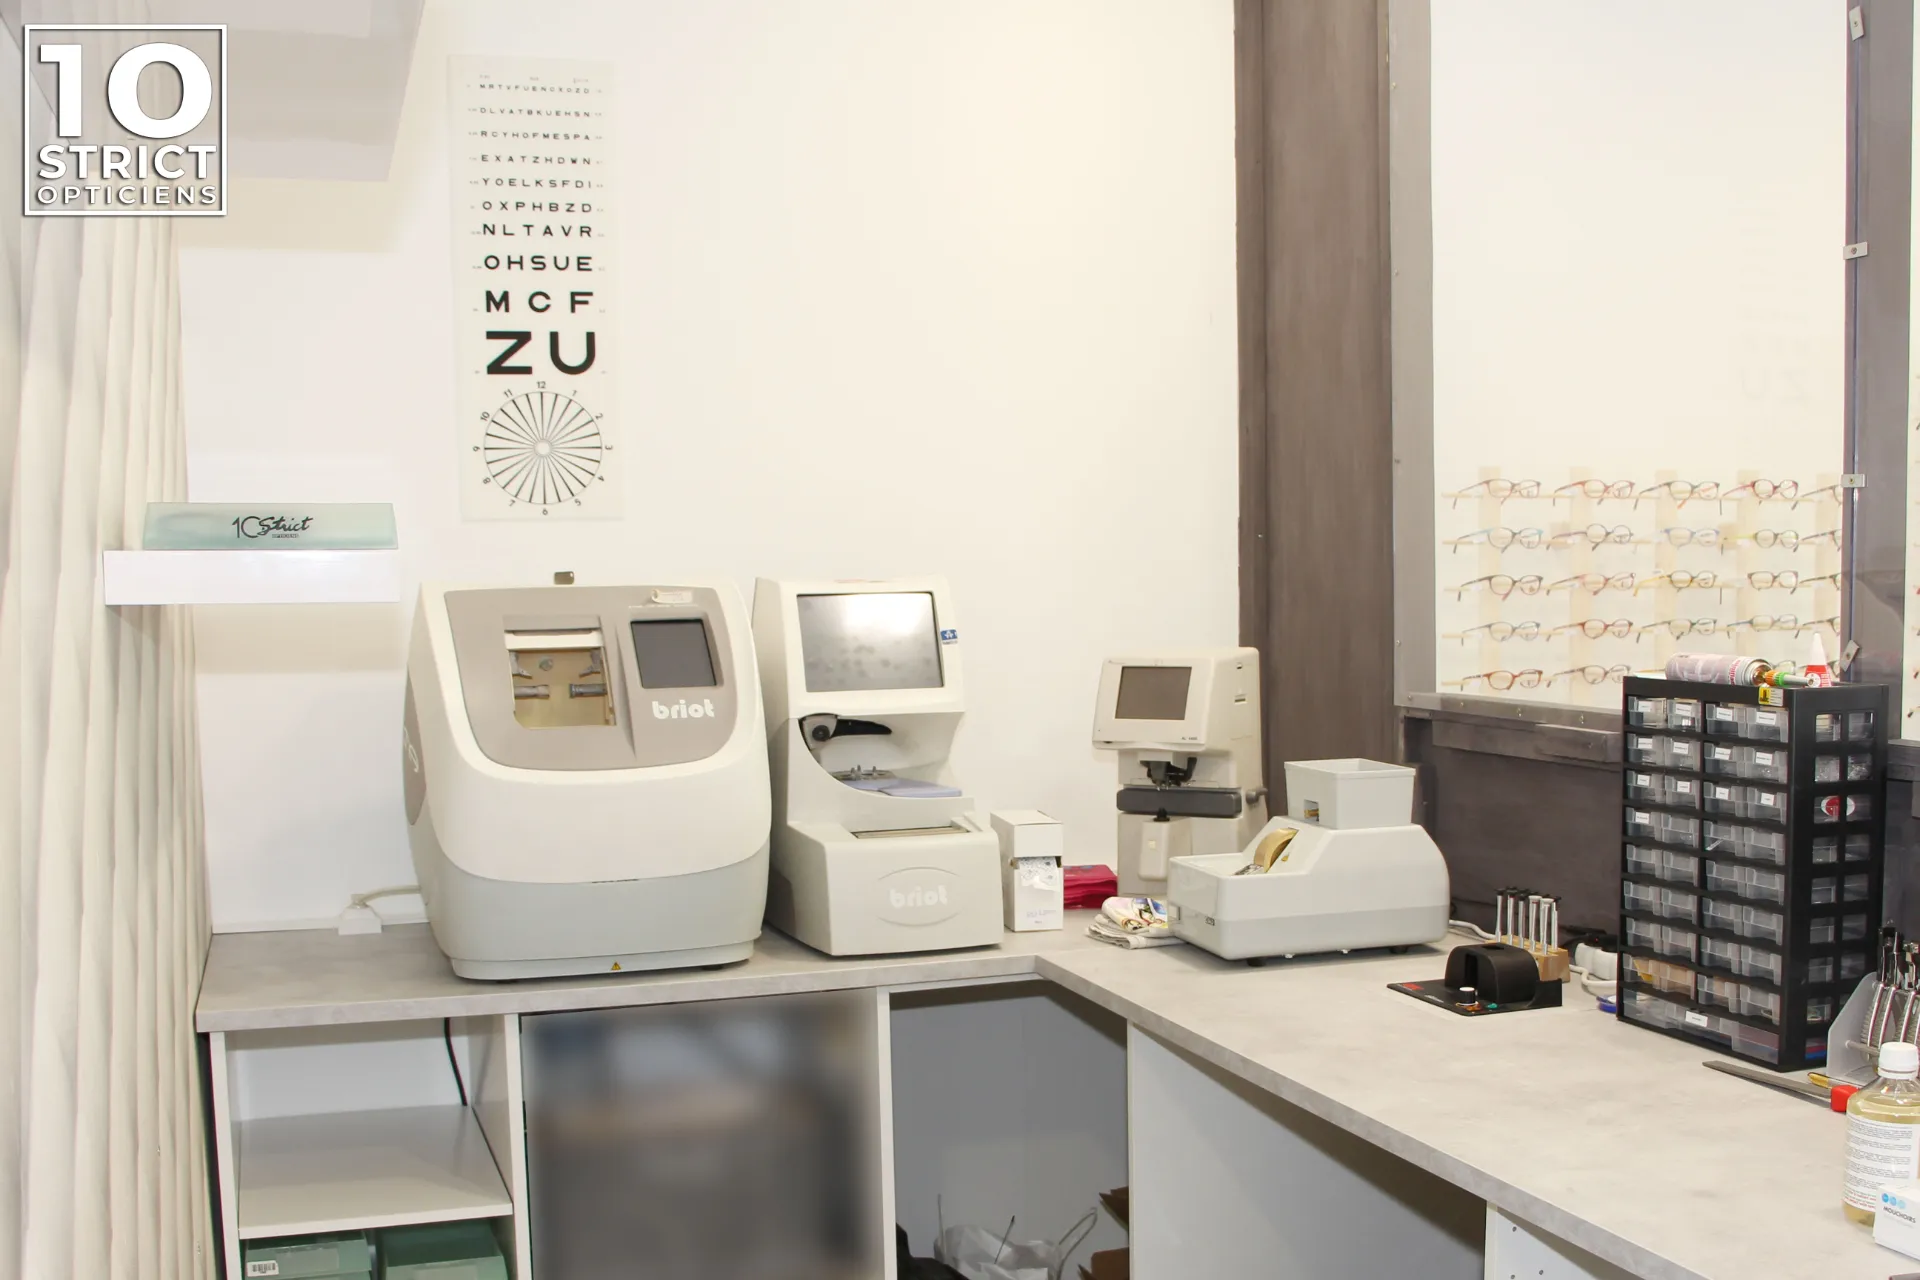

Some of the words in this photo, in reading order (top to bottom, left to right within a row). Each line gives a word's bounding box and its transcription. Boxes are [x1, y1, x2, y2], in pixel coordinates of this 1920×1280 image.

[480, 131, 590, 141] RCYHOFMESPA
[481, 155, 591, 165] EXATZHDWN
[483, 178, 591, 189] YOELKSFDI
[482, 201, 592, 213] OXPHBZD
[482, 224, 592, 237] NLTAVR
[484, 255, 593, 272] OHSUE
[485, 331, 596, 375] ZU
[652, 699, 715, 719] briot
[889, 885, 948, 908] briot
